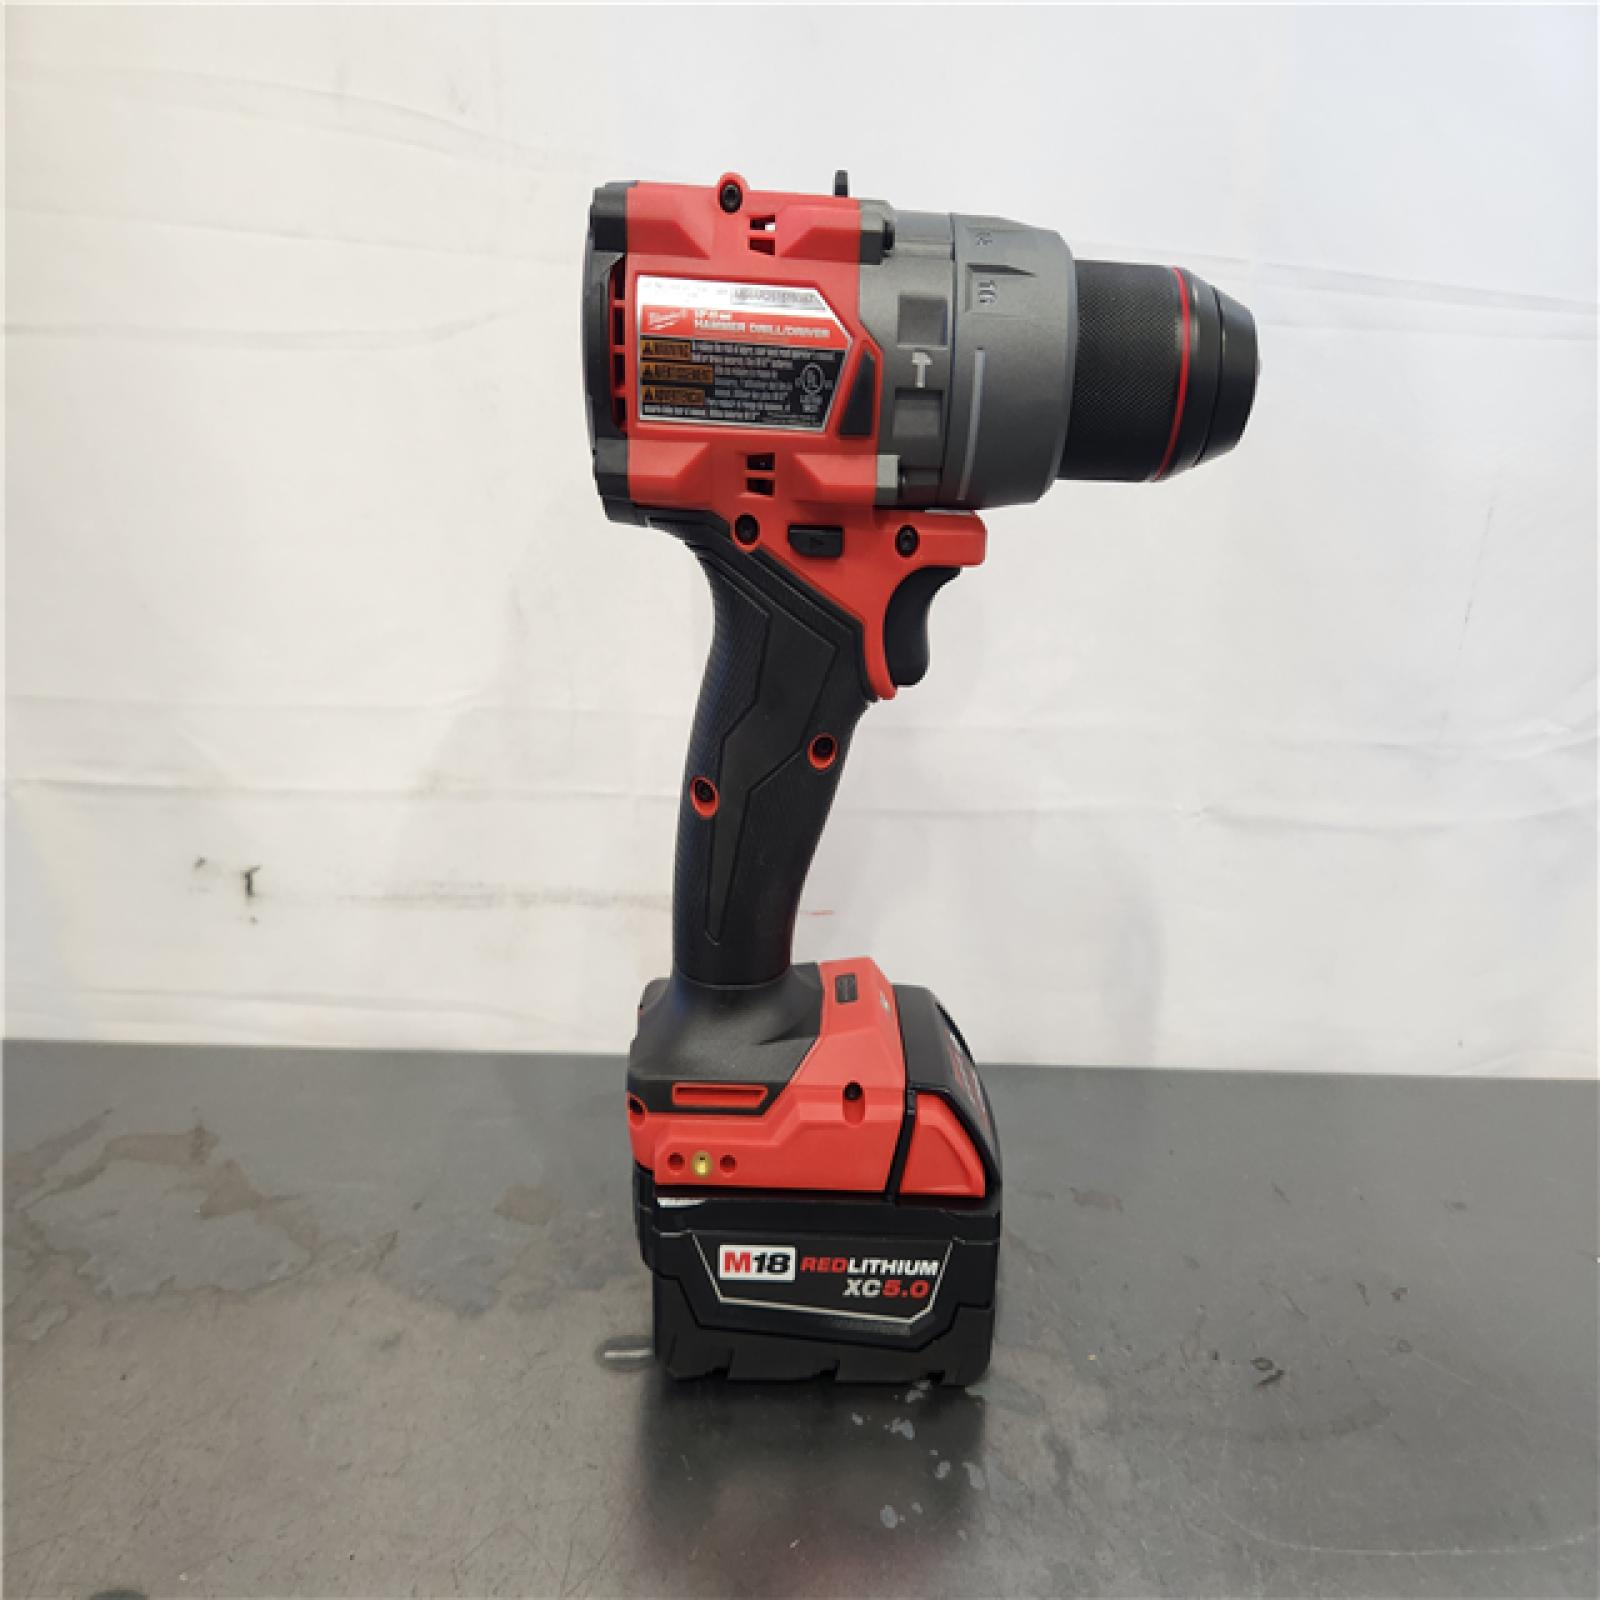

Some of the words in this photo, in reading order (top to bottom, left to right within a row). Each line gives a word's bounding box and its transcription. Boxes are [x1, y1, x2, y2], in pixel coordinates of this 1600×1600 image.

[723, 1250, 791, 1275] M18
[799, 1256, 939, 1277] REDLITHIUM
[842, 1279, 930, 1298] XC5.0
